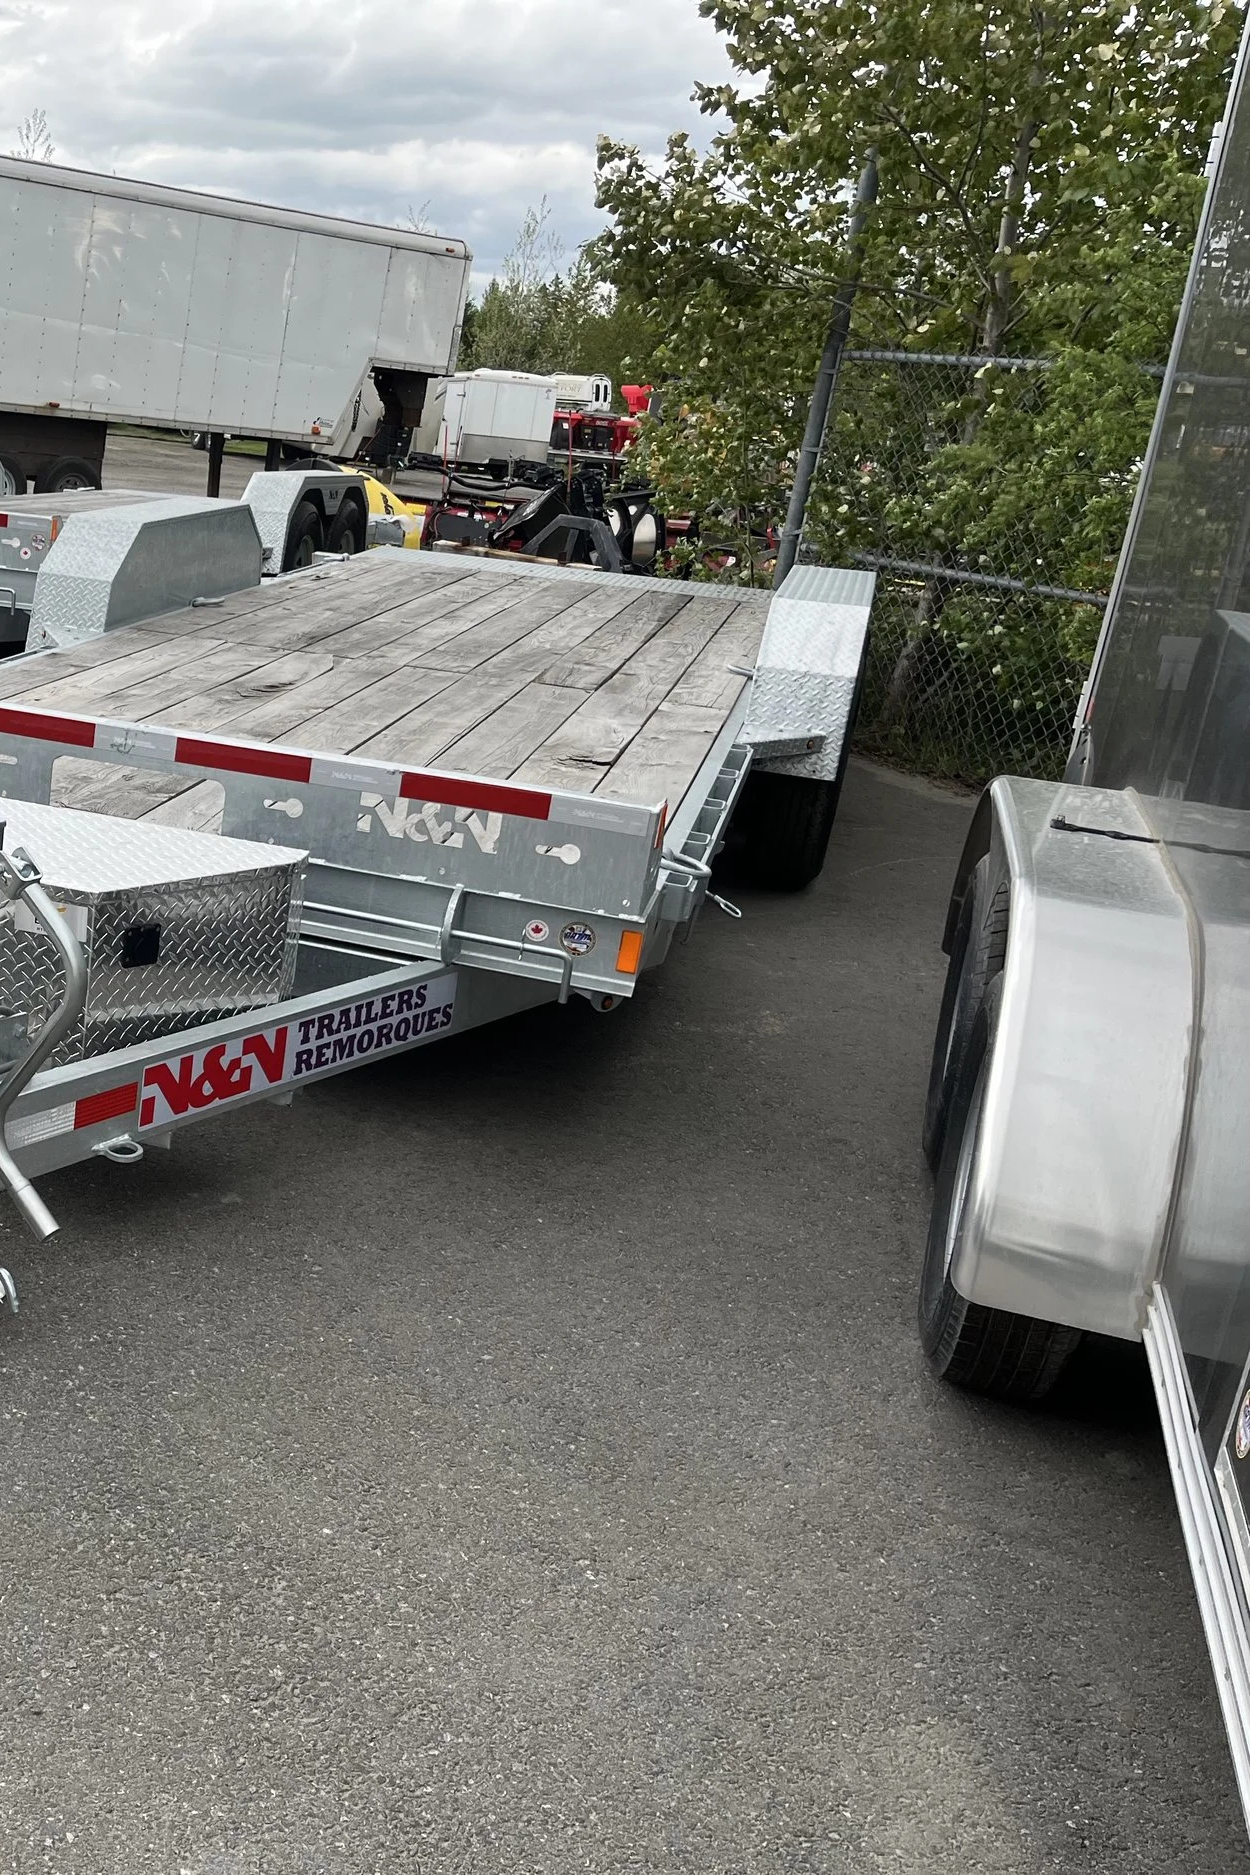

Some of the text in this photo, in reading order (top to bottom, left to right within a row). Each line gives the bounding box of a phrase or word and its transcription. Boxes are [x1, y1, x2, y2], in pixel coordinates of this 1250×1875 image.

[356, 791, 503, 855] N&N
[293, 1003, 454, 1077] REMORQUES
[298, 983, 428, 1045] TRAILERS
[139, 1026, 289, 1128] N&N
